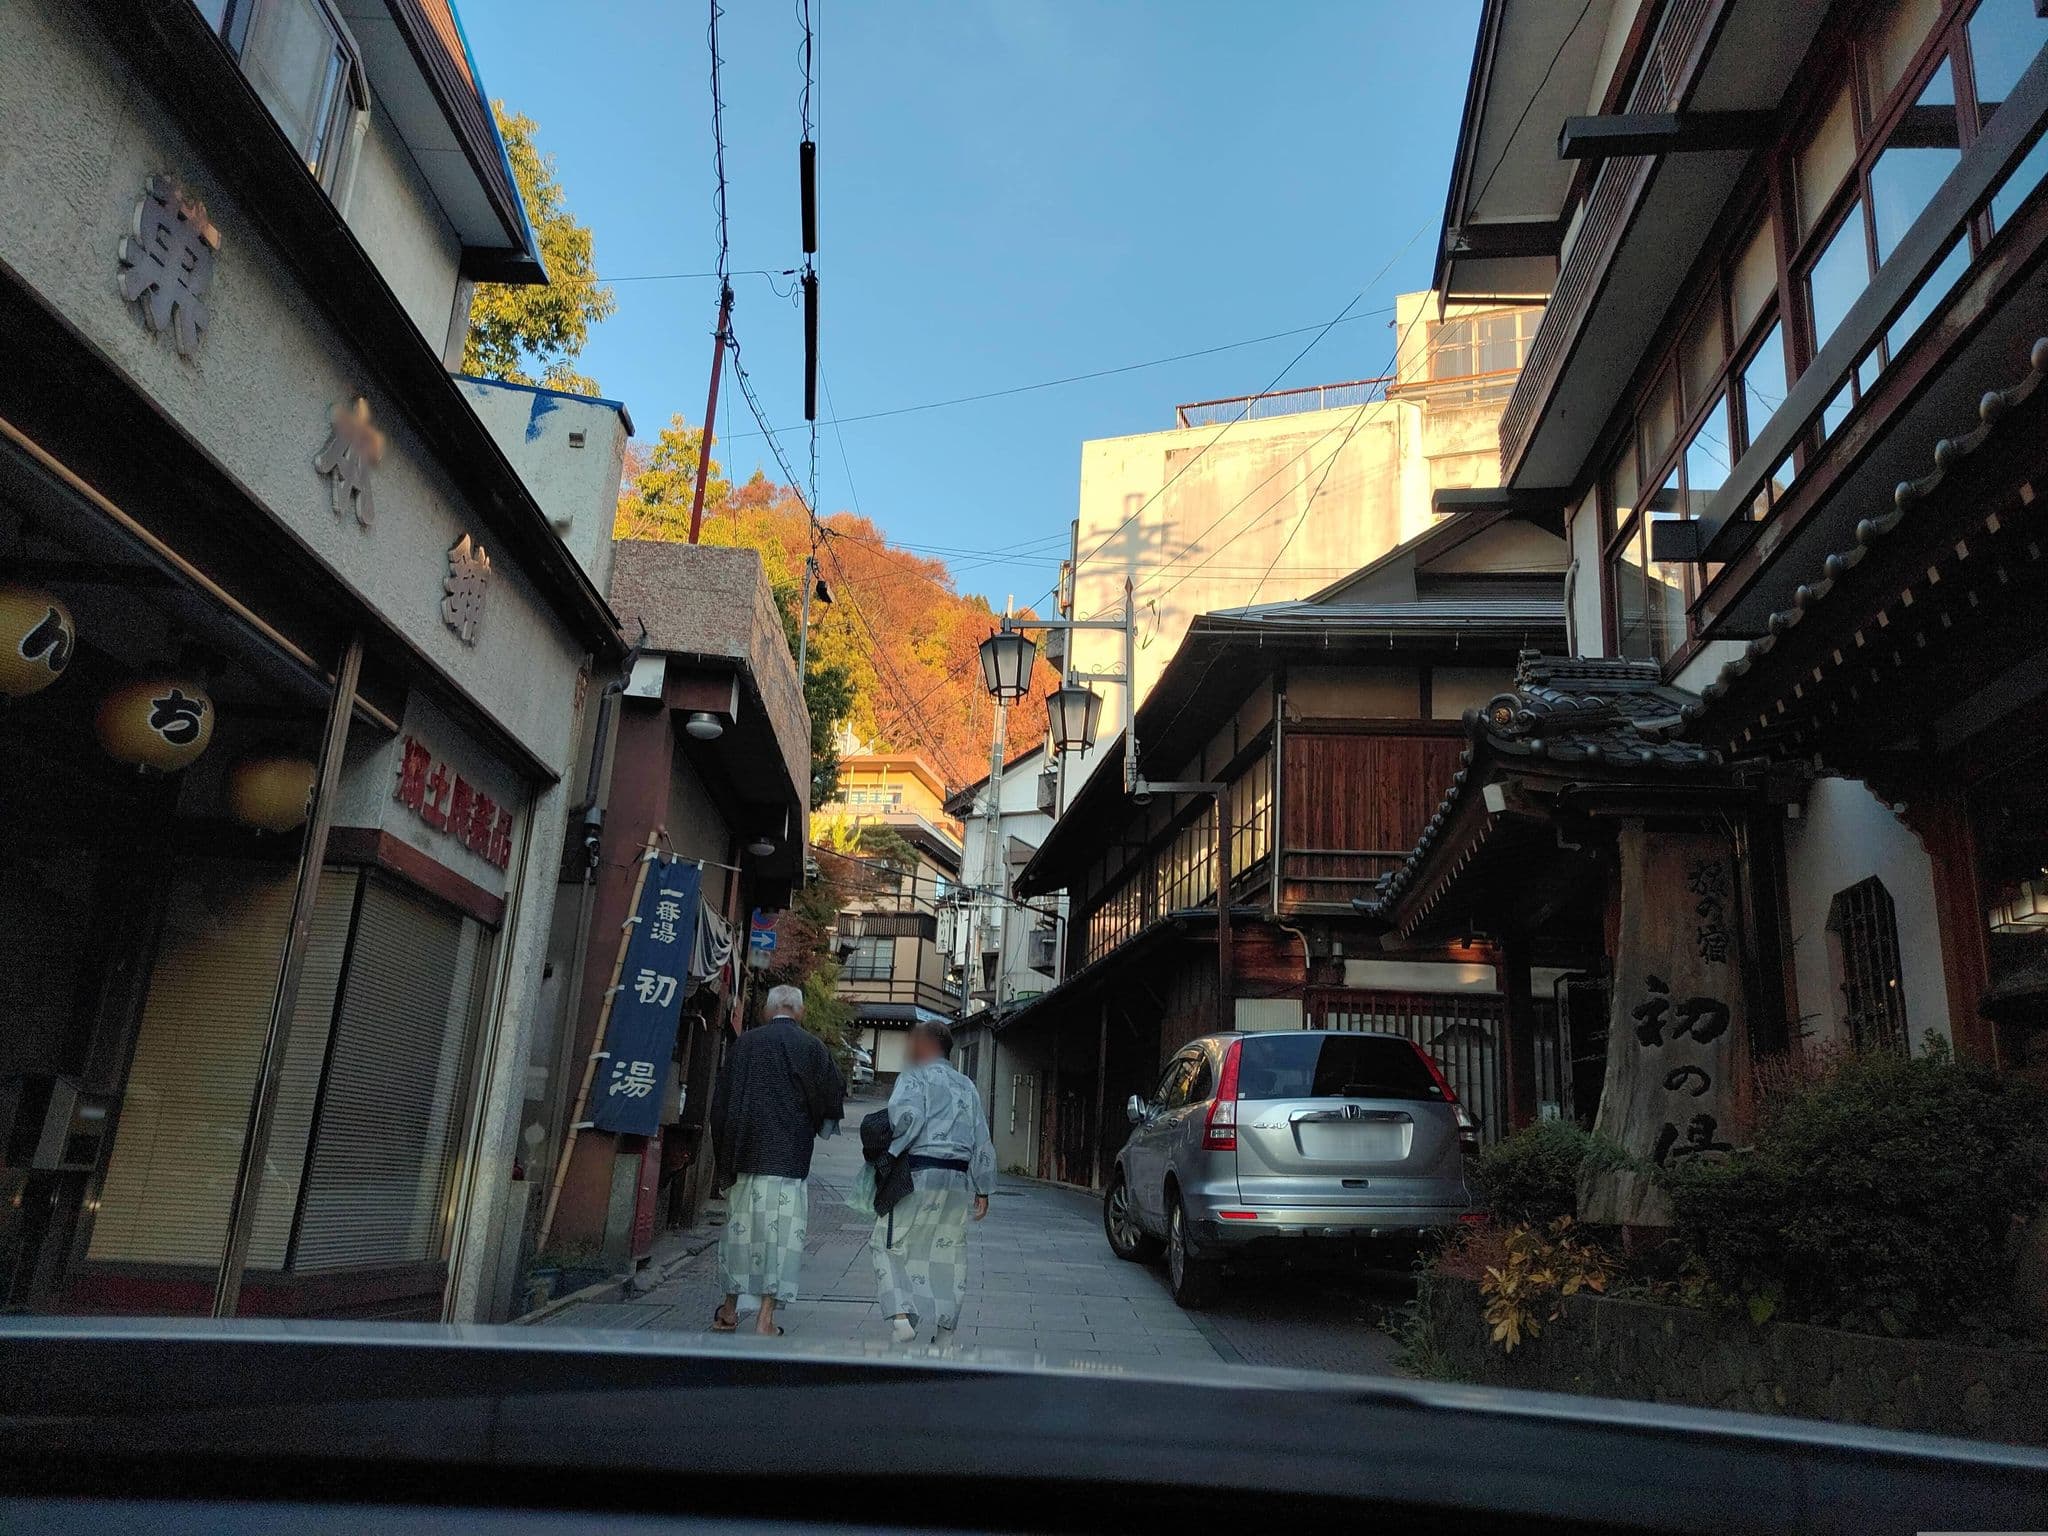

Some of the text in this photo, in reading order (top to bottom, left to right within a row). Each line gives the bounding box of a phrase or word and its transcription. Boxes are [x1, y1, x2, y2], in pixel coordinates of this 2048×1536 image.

[650, 888, 685, 944] 一番湯
[609, 968, 678, 1098] 初湯
